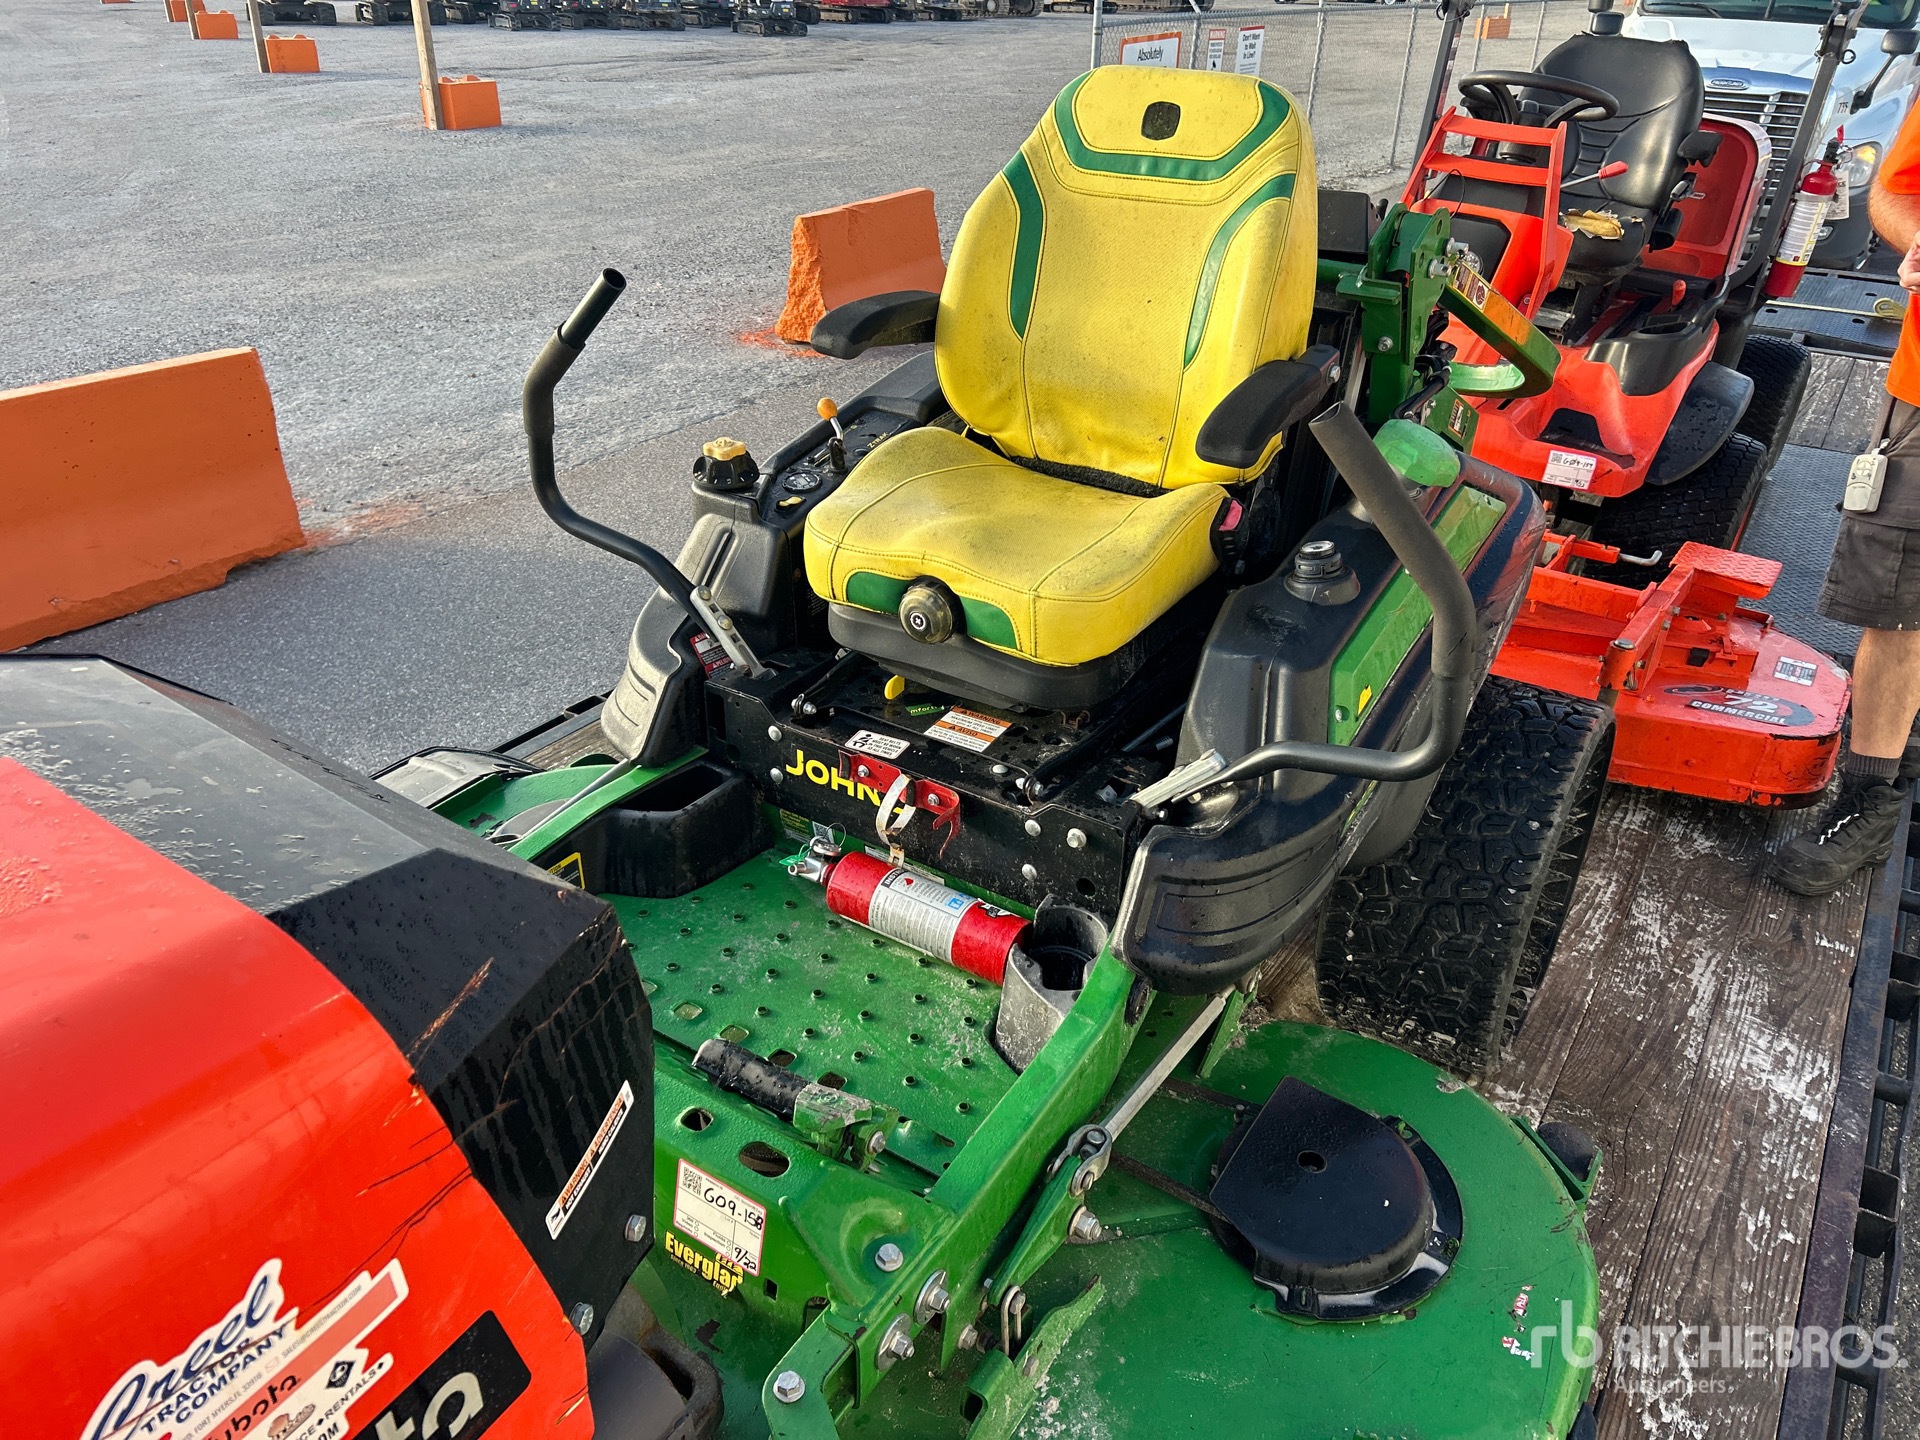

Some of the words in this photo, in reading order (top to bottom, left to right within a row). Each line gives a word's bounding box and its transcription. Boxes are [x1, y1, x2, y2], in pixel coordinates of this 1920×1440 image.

[1137, 46, 1164, 62] Absolutely
[966, 711, 1002, 724] WARNING
[1691, 700, 1786, 725] COMMERCIAL
[1724, 694, 1778, 714] 72
[564, 1158, 590, 1199] WARNING
[594, 1096, 624, 1149] ADVERTENCIA
[566, 1193, 576, 1210] HOT
[574, 1167, 592, 1198] EXHAUST
[734, 1246, 758, 1272] 9/22
[91, 1274, 272, 1440] Creel
[175, 1322, 289, 1424] COMPANY
[140, 1338, 250, 1434] TRACTOR
[324, 1368, 377, 1420] RENTALS
